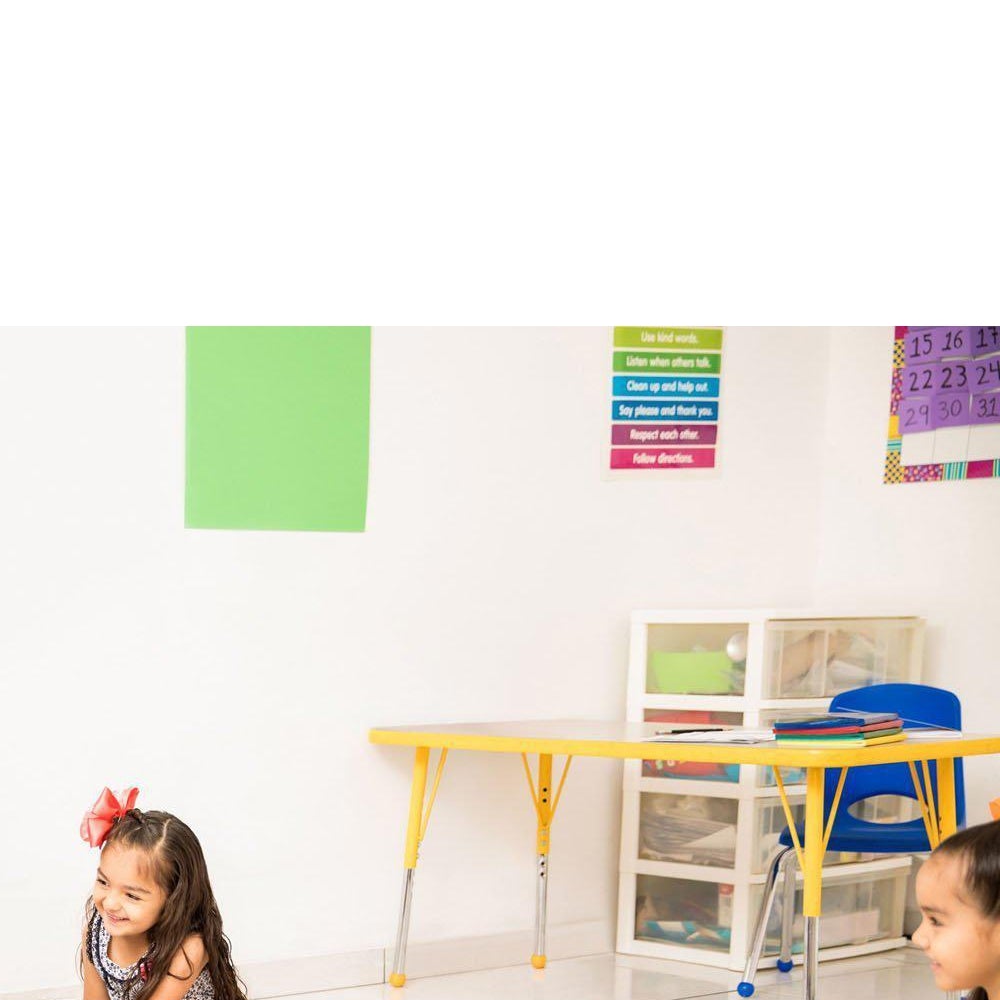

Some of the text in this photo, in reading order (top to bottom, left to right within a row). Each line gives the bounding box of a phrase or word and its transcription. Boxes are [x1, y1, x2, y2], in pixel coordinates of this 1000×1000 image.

[640, 331, 698, 344] Use kind words.
[909, 326, 1000, 358] 15 16 17
[626, 356, 712, 368] Listen when others talk.
[909, 360, 1000, 392] 22 23 24
[626, 380, 709, 394] Clean up and help out.
[618, 404, 713, 418] Say please and thank you.
[904, 397, 1000, 427] 29 30 31
[630, 428, 700, 442] Respect each other.
[632, 452, 694, 464] Follow directions.
